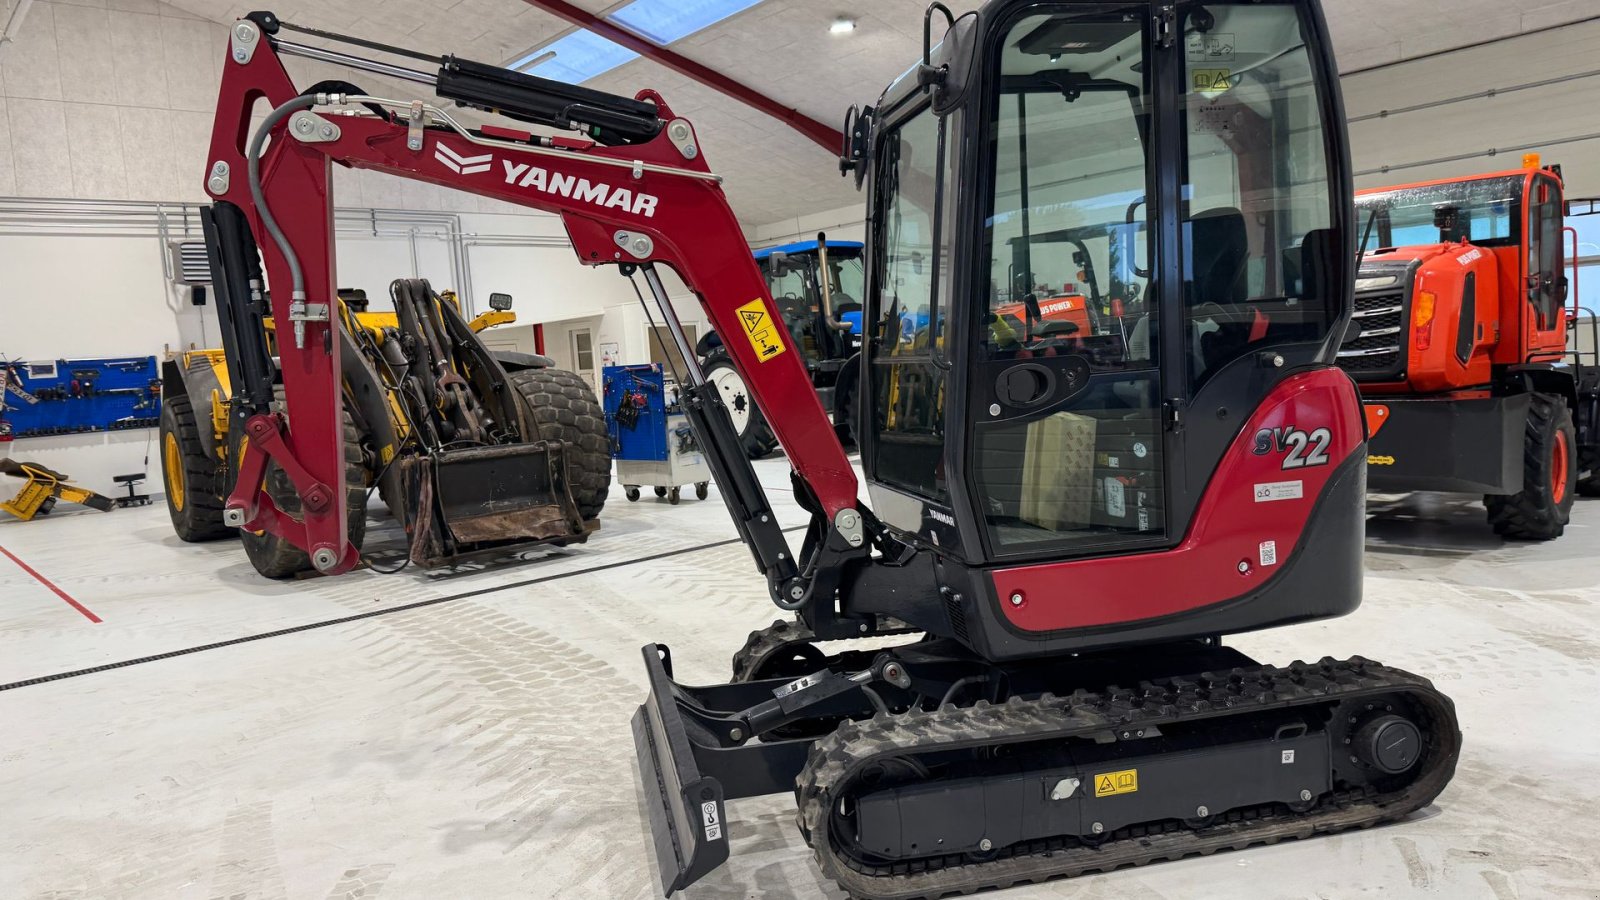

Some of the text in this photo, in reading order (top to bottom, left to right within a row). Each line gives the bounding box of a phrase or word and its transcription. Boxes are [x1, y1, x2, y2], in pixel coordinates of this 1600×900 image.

[502, 159, 659, 218] YANMAR
[1049, 300, 1072, 313] POWER
[1253, 424, 1332, 471] SV22
[928, 507, 956, 528] YANMAR
